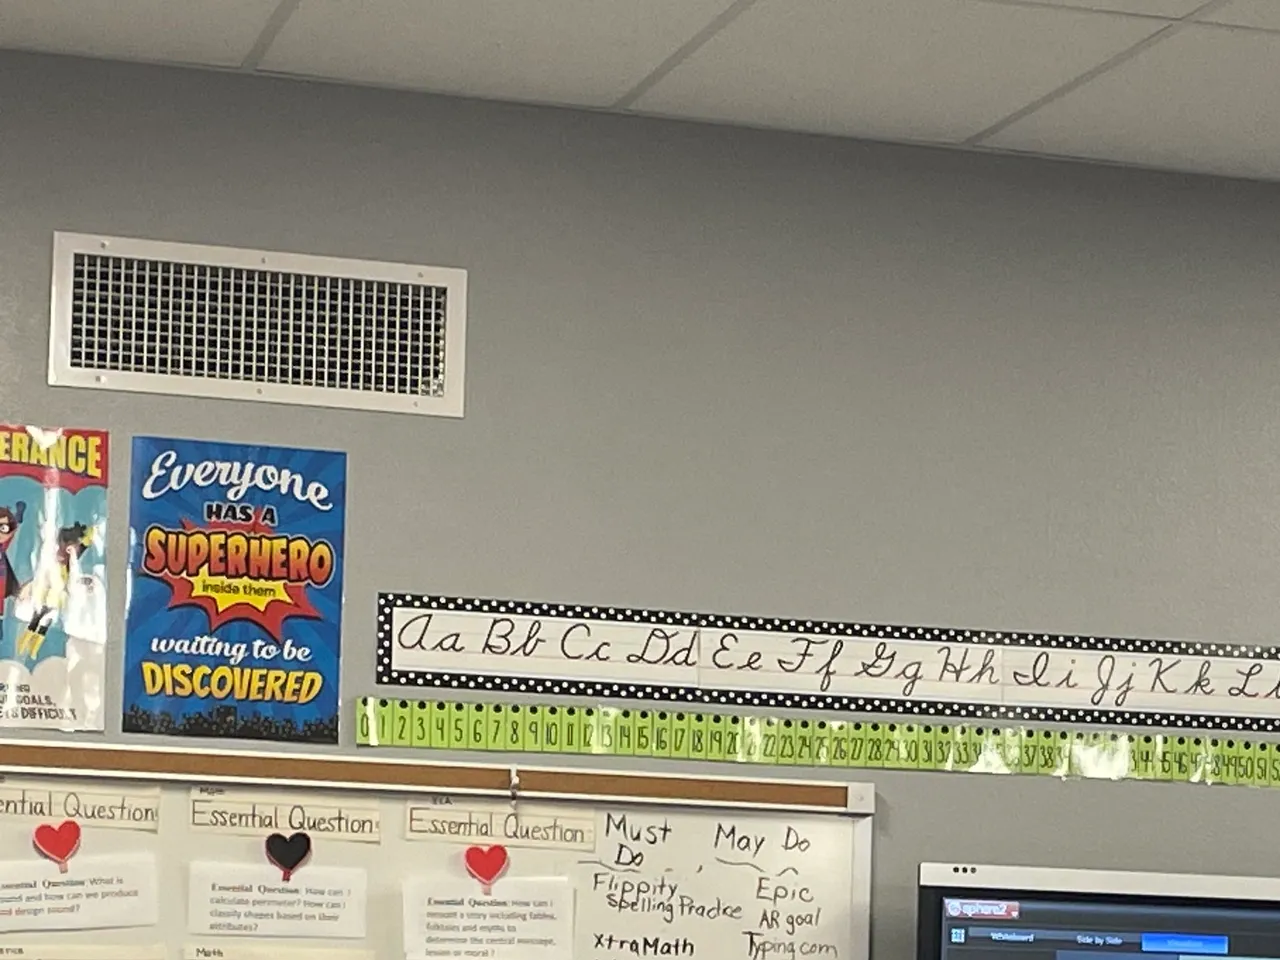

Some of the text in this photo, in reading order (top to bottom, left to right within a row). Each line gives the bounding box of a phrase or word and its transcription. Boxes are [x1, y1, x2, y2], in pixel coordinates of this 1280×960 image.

[142, 450, 333, 511] Everyone
[204, 503, 278, 526] HAS A
[145, 528, 335, 586] SUPERHERO
[201, 579, 277, 597] inside them
[151, 635, 313, 665] waiting to be
[397, 613, 465, 651] Aa
[482, 617, 547, 657] Bb
[560, 623, 611, 662] Cc
[626, 627, 699, 667] Dd
[711, 633, 763, 672] Ee
[777, 637, 844, 692] Ff
[854, 641, 924, 697] Gg
[937, 646, 1000, 685] Hh
[1013, 651, 1080, 689] Ii
[1090, 654, 1137, 706] Jj
[1149, 657, 1215, 697] Kk
[141, 661, 324, 705] DISCOVERED
[381, 717, 882, 761] 1 2 3 4 5 6 7 8 9 10 14 17 23 28
[192, 799, 279, 829] Essential
[410, 807, 494, 838] Essential
[605, 813, 812, 861] Must May Do
[614, 843, 645, 867] Do
[593, 871, 814, 906] Flippity Epic
[759, 908, 821, 935] AR goal
